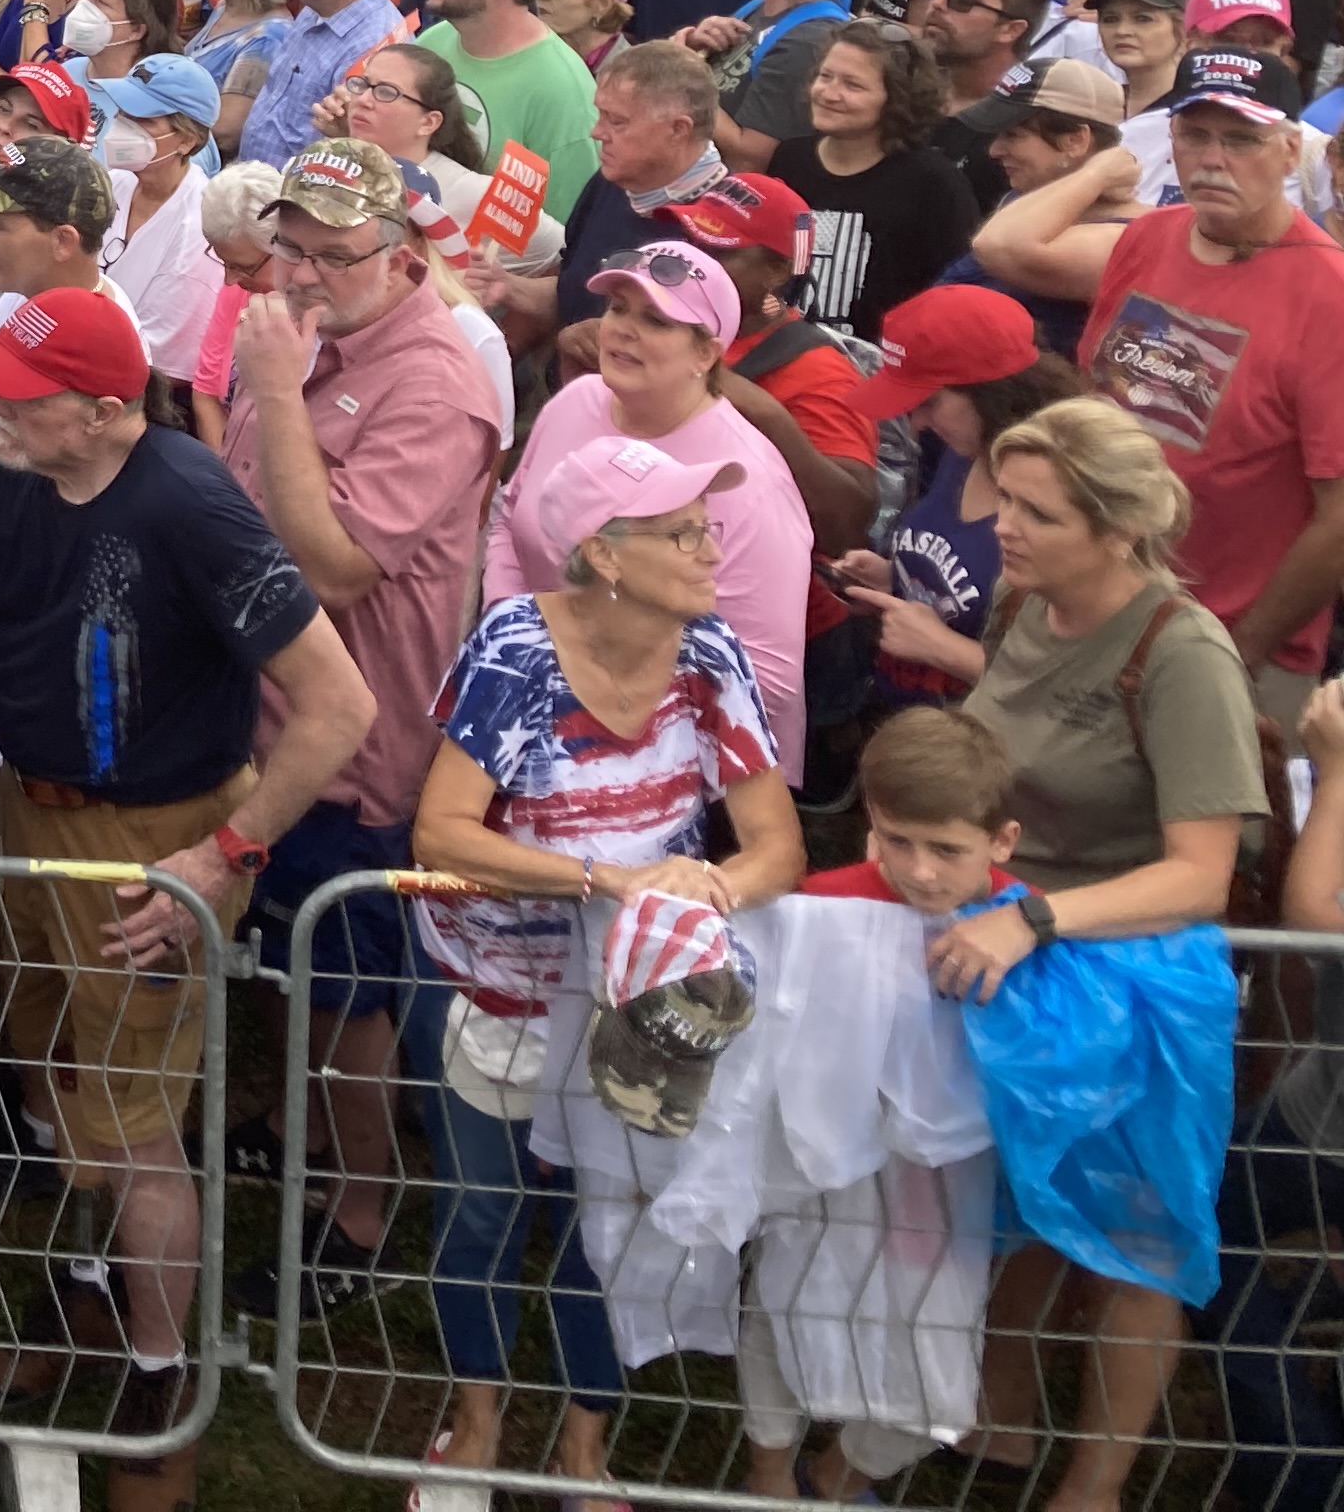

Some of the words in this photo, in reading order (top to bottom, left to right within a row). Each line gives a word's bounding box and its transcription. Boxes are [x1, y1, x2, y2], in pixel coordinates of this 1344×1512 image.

[1193, 54, 1263, 77] Trump
[1203, 71, 1243, 82] 2020
[283, 152, 364, 179] Trump
[501, 152, 548, 196] LINDY
[299, 172, 337, 187] 2020
[492, 178, 535, 218] LOVES
[483, 201, 525, 238] ALABAMA
[9, 323, 40, 351] TRUMP
